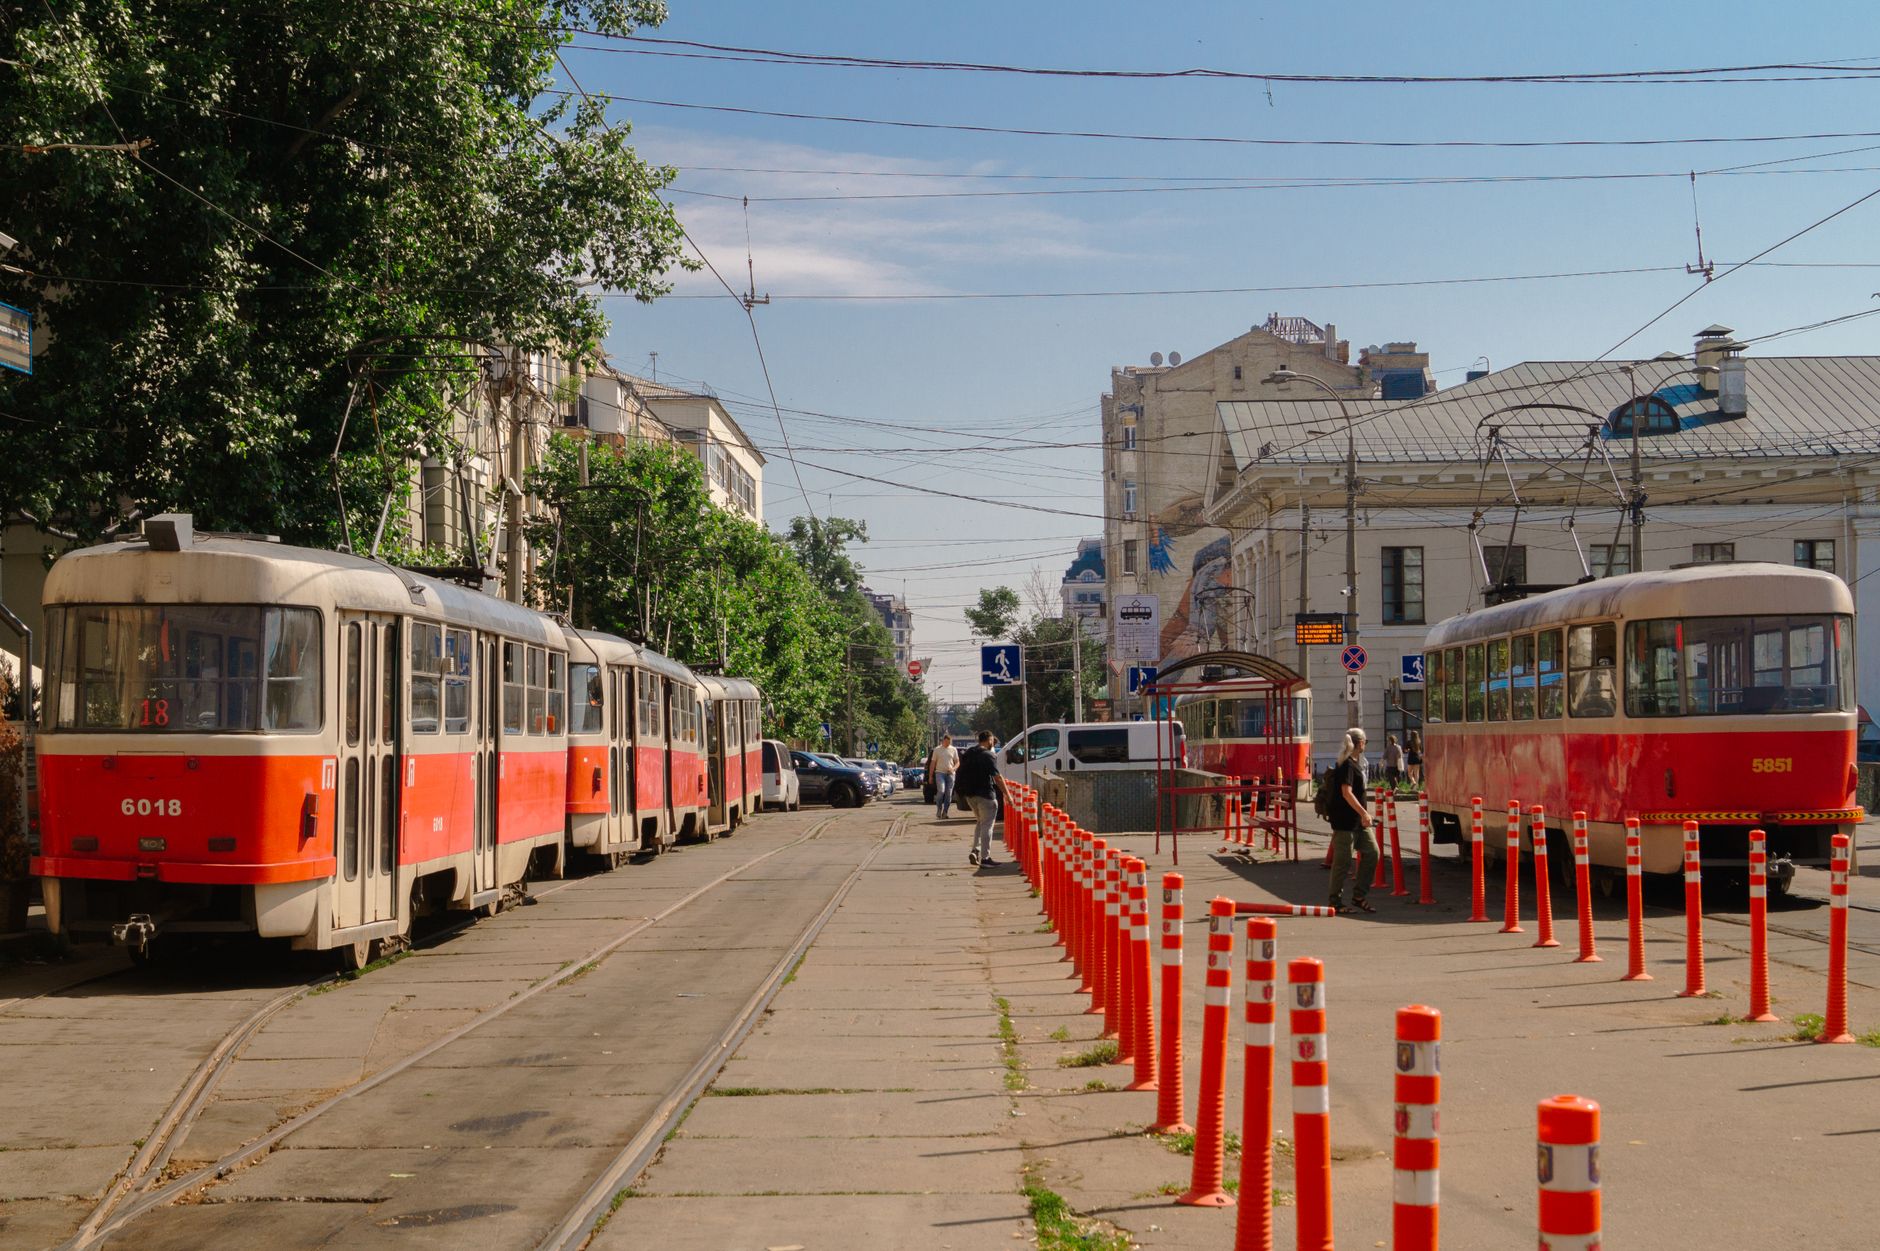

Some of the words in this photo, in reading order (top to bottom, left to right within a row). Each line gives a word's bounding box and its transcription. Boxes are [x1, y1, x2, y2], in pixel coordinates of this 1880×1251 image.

[140, 699, 169, 726] 18
[1752, 757, 1792, 773] 5851
[121, 798, 182, 816] 6018
